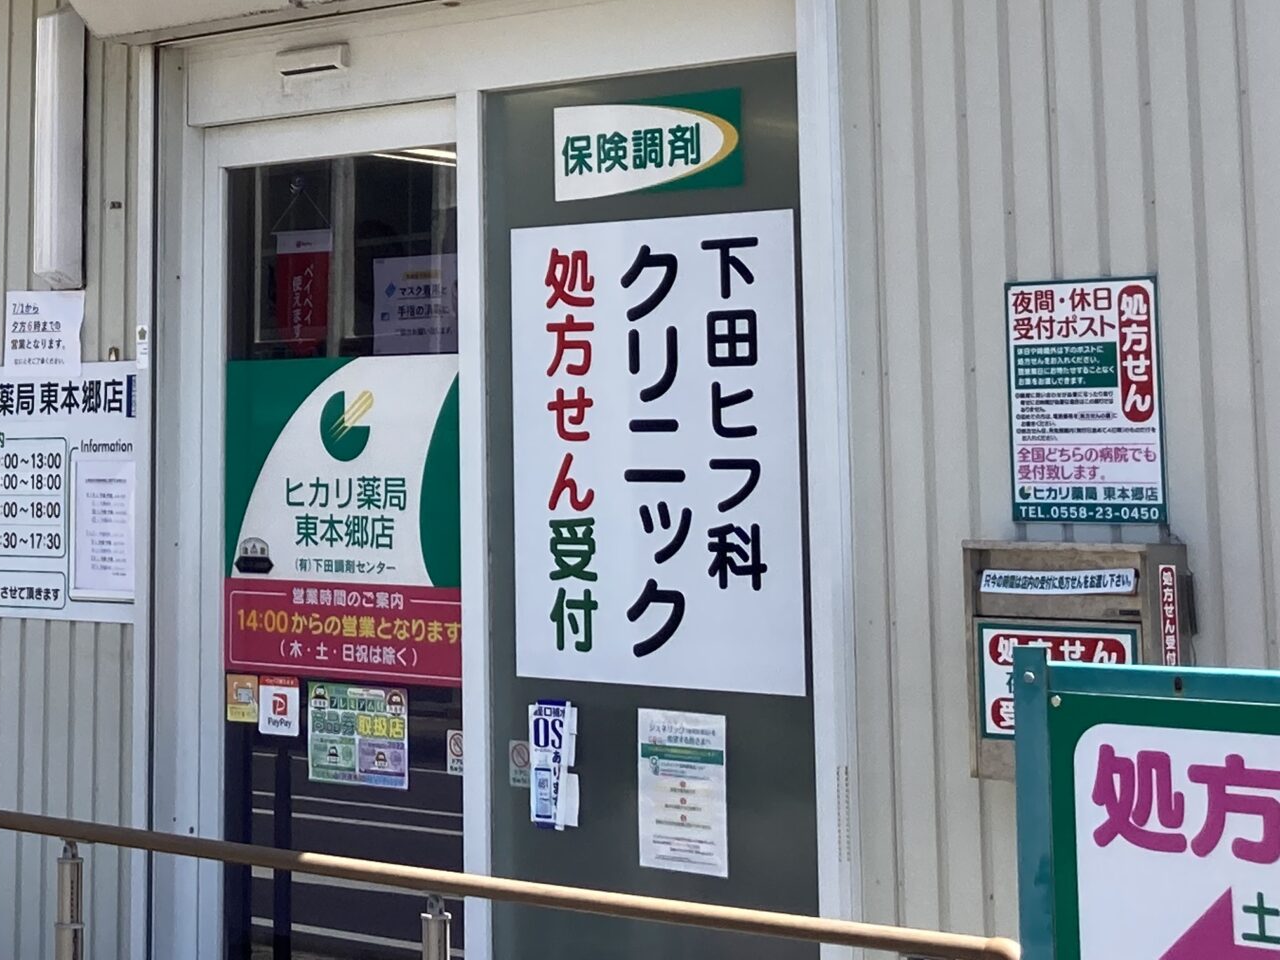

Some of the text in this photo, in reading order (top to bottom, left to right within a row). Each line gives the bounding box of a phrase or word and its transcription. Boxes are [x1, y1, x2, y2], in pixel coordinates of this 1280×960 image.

[561, 122, 701, 176] 保険調剤
[1012, 287, 1112, 314] 夜間・休日
[1013, 314, 1116, 340] 受付ポスト
[1121, 293, 1152, 413] 処方せん
[700, 236, 767, 591] 下田ヒフ科
[80, 439, 133, 453] Information
[543, 247, 598, 653] 処方せん受付
[620, 244, 693, 658] クリニック
[1017, 447, 1156, 462] 全国どちらの病院でも
[1017, 465, 1106, 480] 受付致します。
[285, 476, 407, 511] ヒカリ薬局
[1033, 486, 1158, 501] ヒカリ薬局 東本郷店
[1019, 506, 1159, 519] TEL.0558-23-0450
[295, 513, 395, 549] 東本郷店
[292, 587, 404, 609] 営業時間のご案内
[268, 718, 293, 729] PayPay
[1092, 743, 1280, 865] 処方
